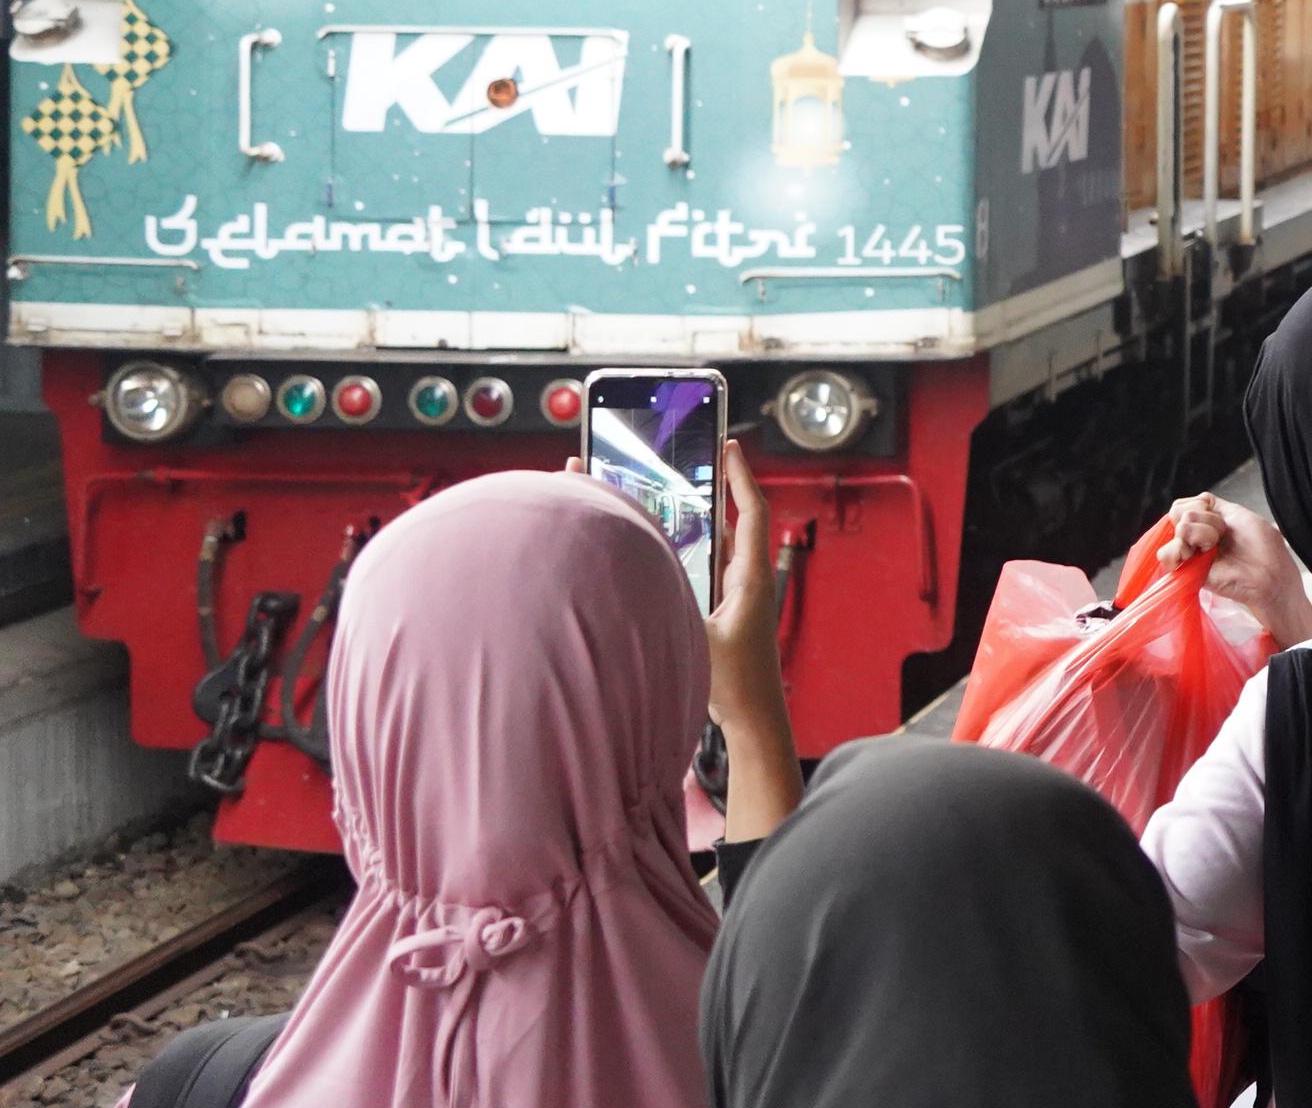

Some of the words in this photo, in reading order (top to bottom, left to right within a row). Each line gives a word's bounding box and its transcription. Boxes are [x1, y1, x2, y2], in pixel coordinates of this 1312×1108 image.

[342, 31, 628, 137] KAI
[1020, 66, 1092, 174] KAI
[145, 194, 466, 269] Selamat
[836, 223, 967, 266] 1445
